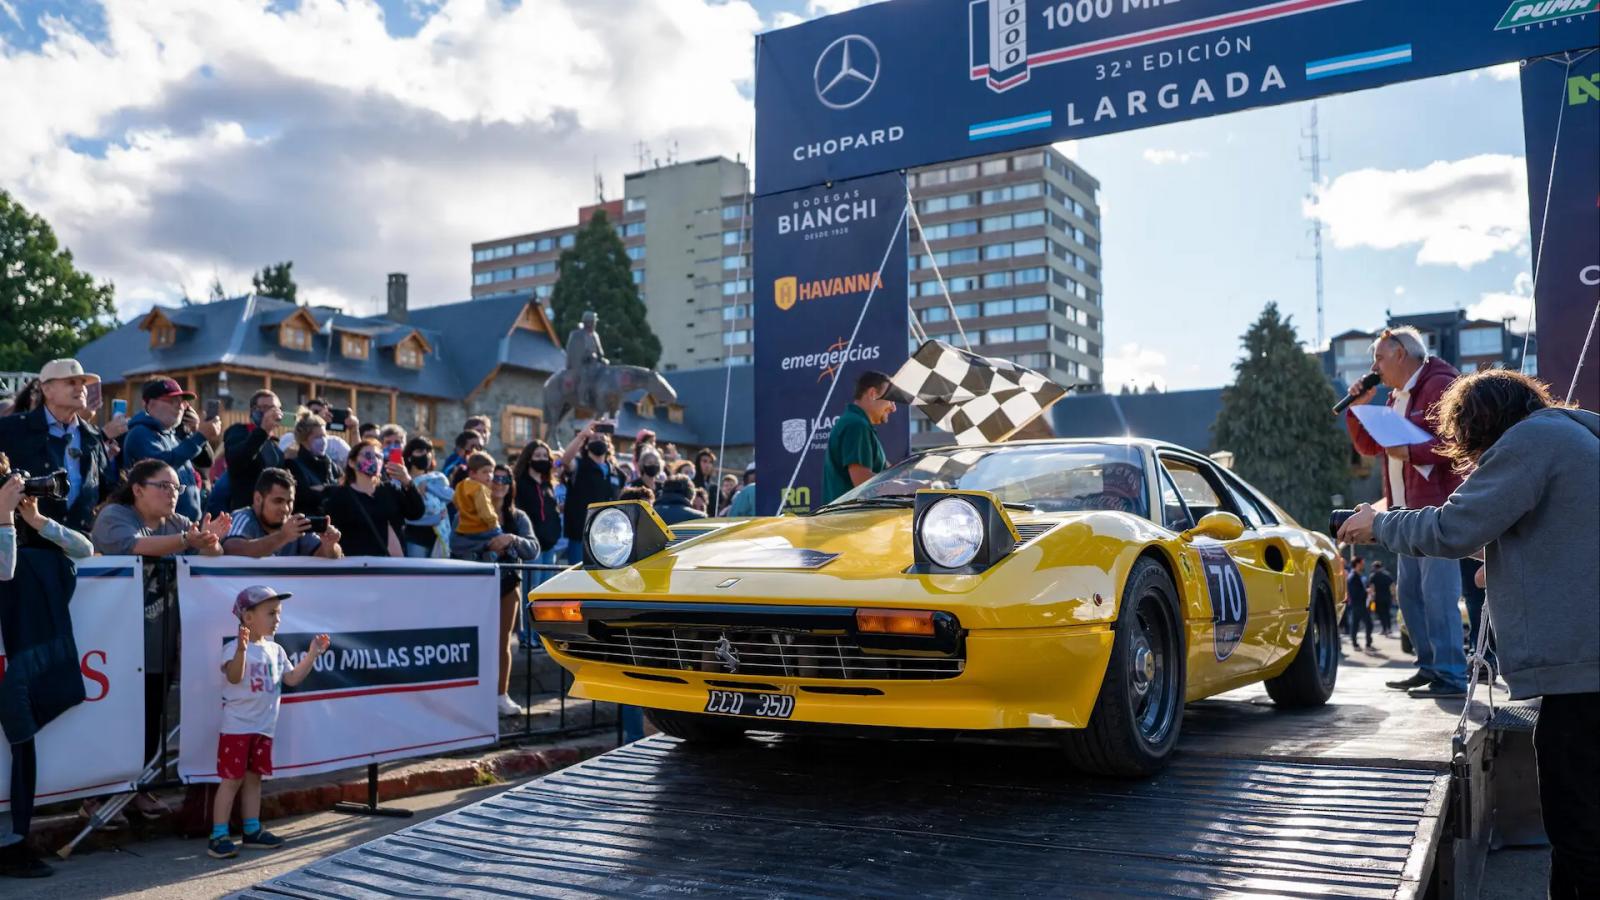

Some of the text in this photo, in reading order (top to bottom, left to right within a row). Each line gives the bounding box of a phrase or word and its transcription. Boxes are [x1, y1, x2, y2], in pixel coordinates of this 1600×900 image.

[1042, 0, 1113, 30] 1000
[1511, 14, 1586, 34] ENERGY
[1143, 35, 1252, 72] EDICIÓN
[1067, 64, 1287, 127] LARGADA
[792, 125, 904, 161] CHOPARD
[793, 189, 860, 210] BODEGAS
[777, 198, 877, 235] BIANCHI
[804, 230, 829, 241] DESDE
[799, 271, 883, 301] HAVANNA
[781, 343, 881, 371] emergencias
[1208, 564, 1241, 621] 70
[340, 647, 410, 671] MILLAS
[414, 643, 471, 666] SPORT
